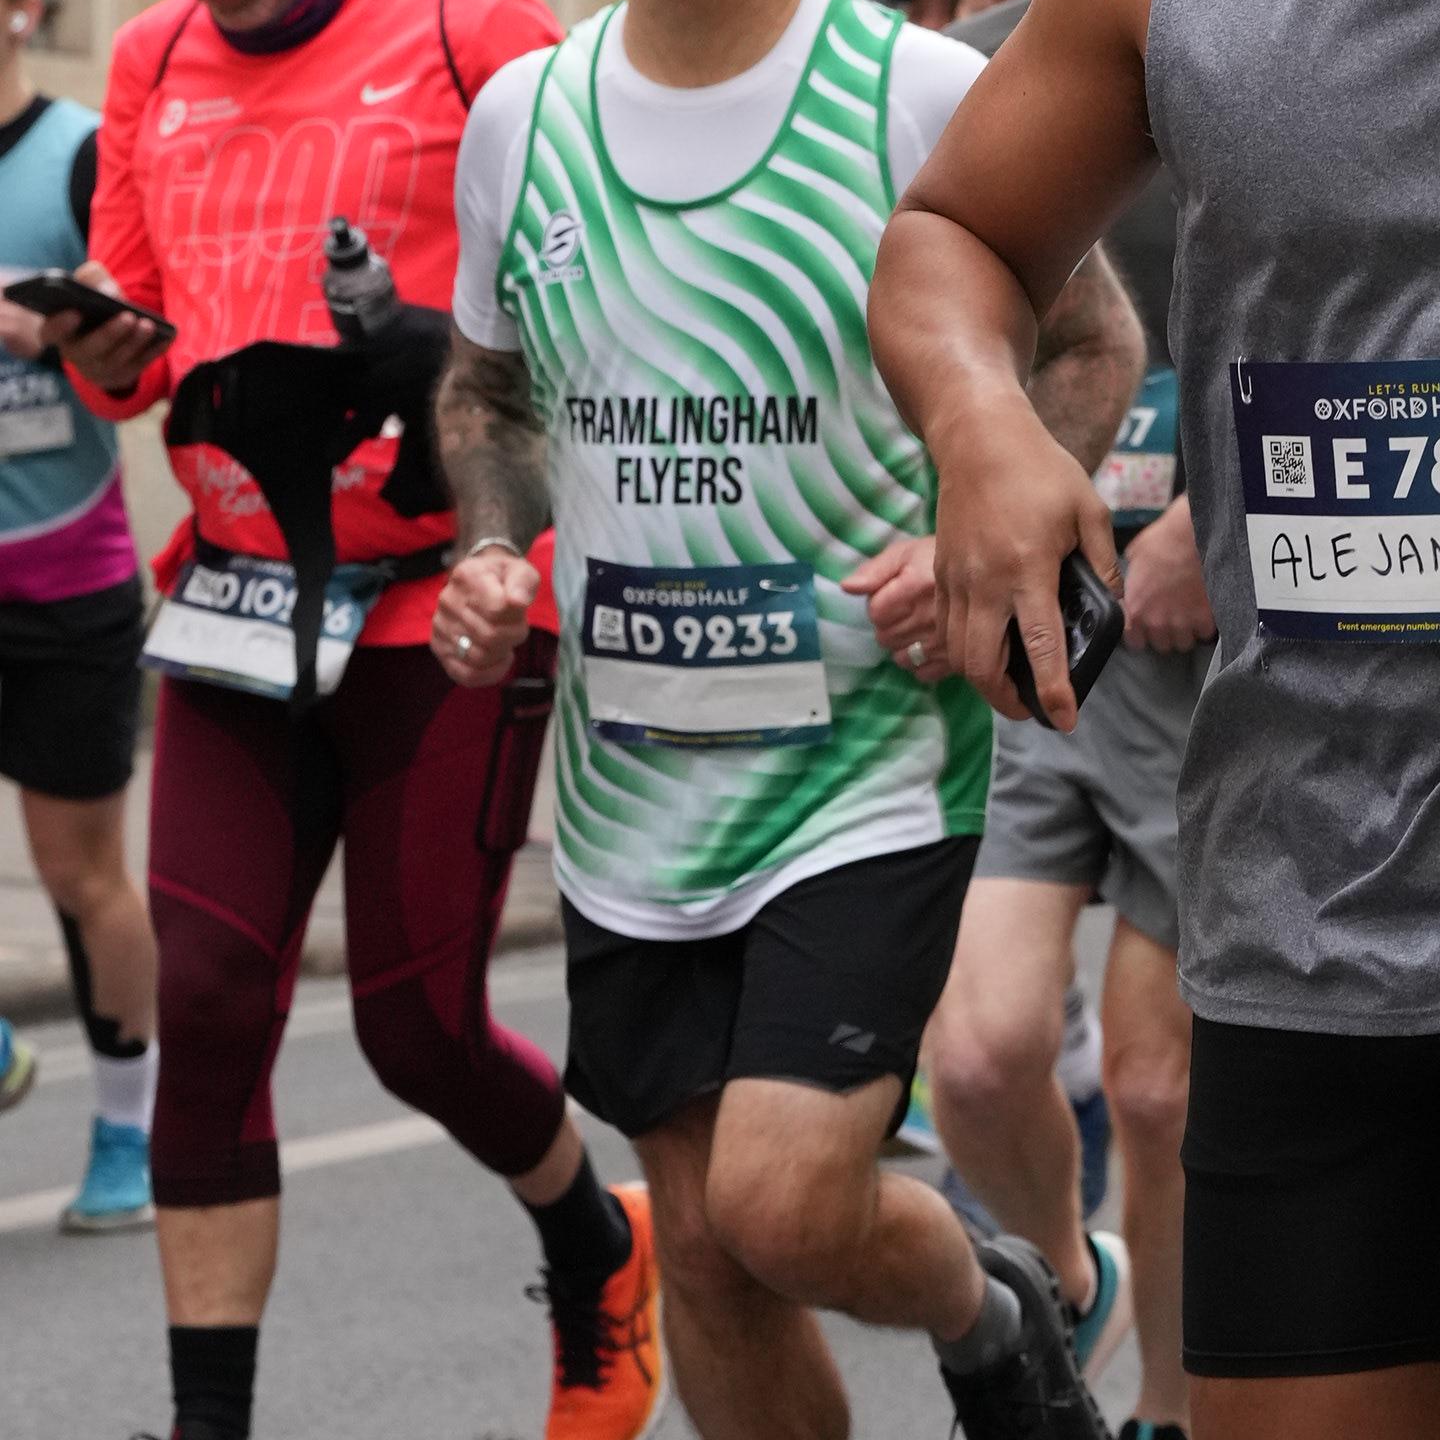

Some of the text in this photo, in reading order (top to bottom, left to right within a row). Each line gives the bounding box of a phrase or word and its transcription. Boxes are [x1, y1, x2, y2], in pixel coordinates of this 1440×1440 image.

[1368, 383, 1440, 395] LET'S RUN
[566, 396, 817, 445] FRAMLINGHAM
[616, 456, 743, 505] FLYERS
[1332, 438, 1371, 499] E
[631, 611, 799, 659] D 9233
[1337, 621, 1359, 631] Event
[1360, 622, 1405, 633] emergency
